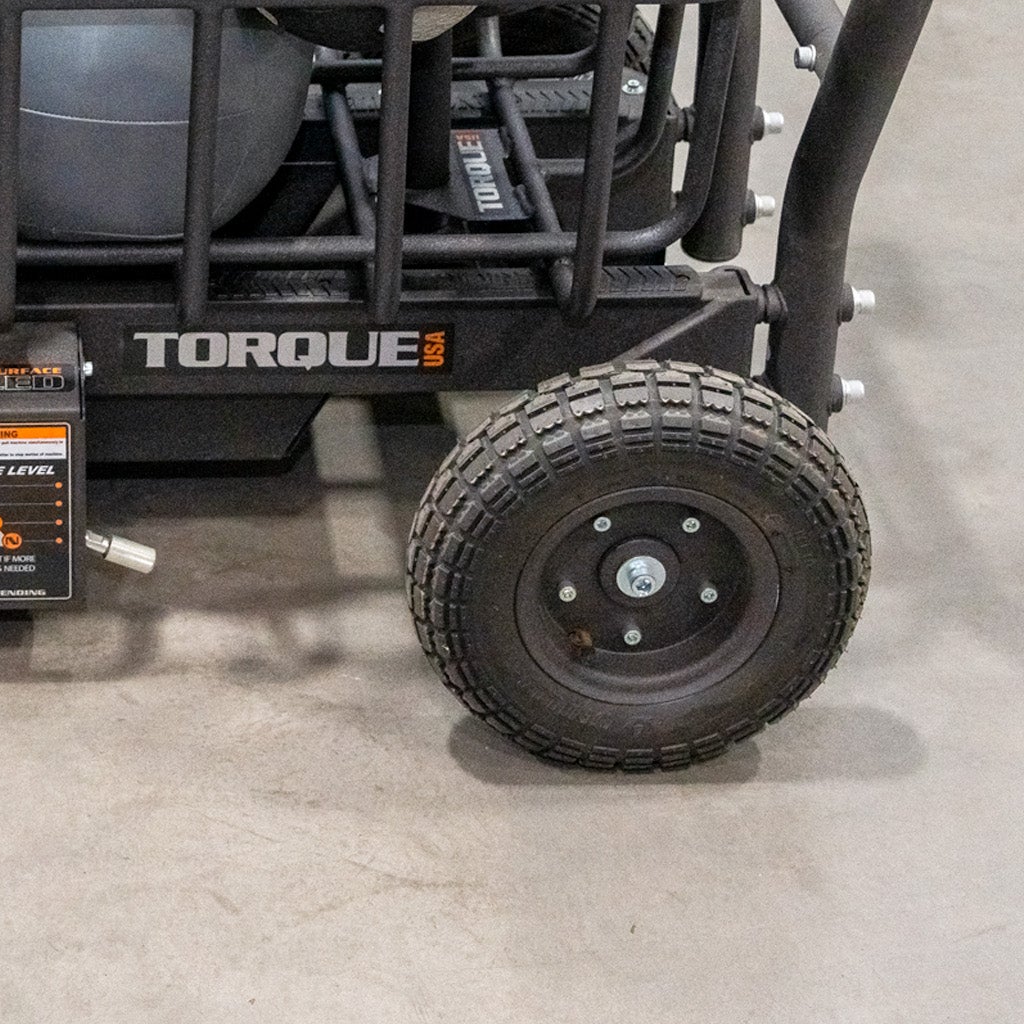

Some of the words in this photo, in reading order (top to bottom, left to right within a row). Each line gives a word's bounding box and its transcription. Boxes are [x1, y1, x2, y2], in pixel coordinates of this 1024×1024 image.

[457, 141, 504, 213] TORQUE
[133, 330, 420, 371] TORQUE
[422, 330, 445, 368] USA
[7, 465, 55, 475] LEVEL
[4, 555, 11, 563] IF
[4, 564, 36, 572] NEEDED
